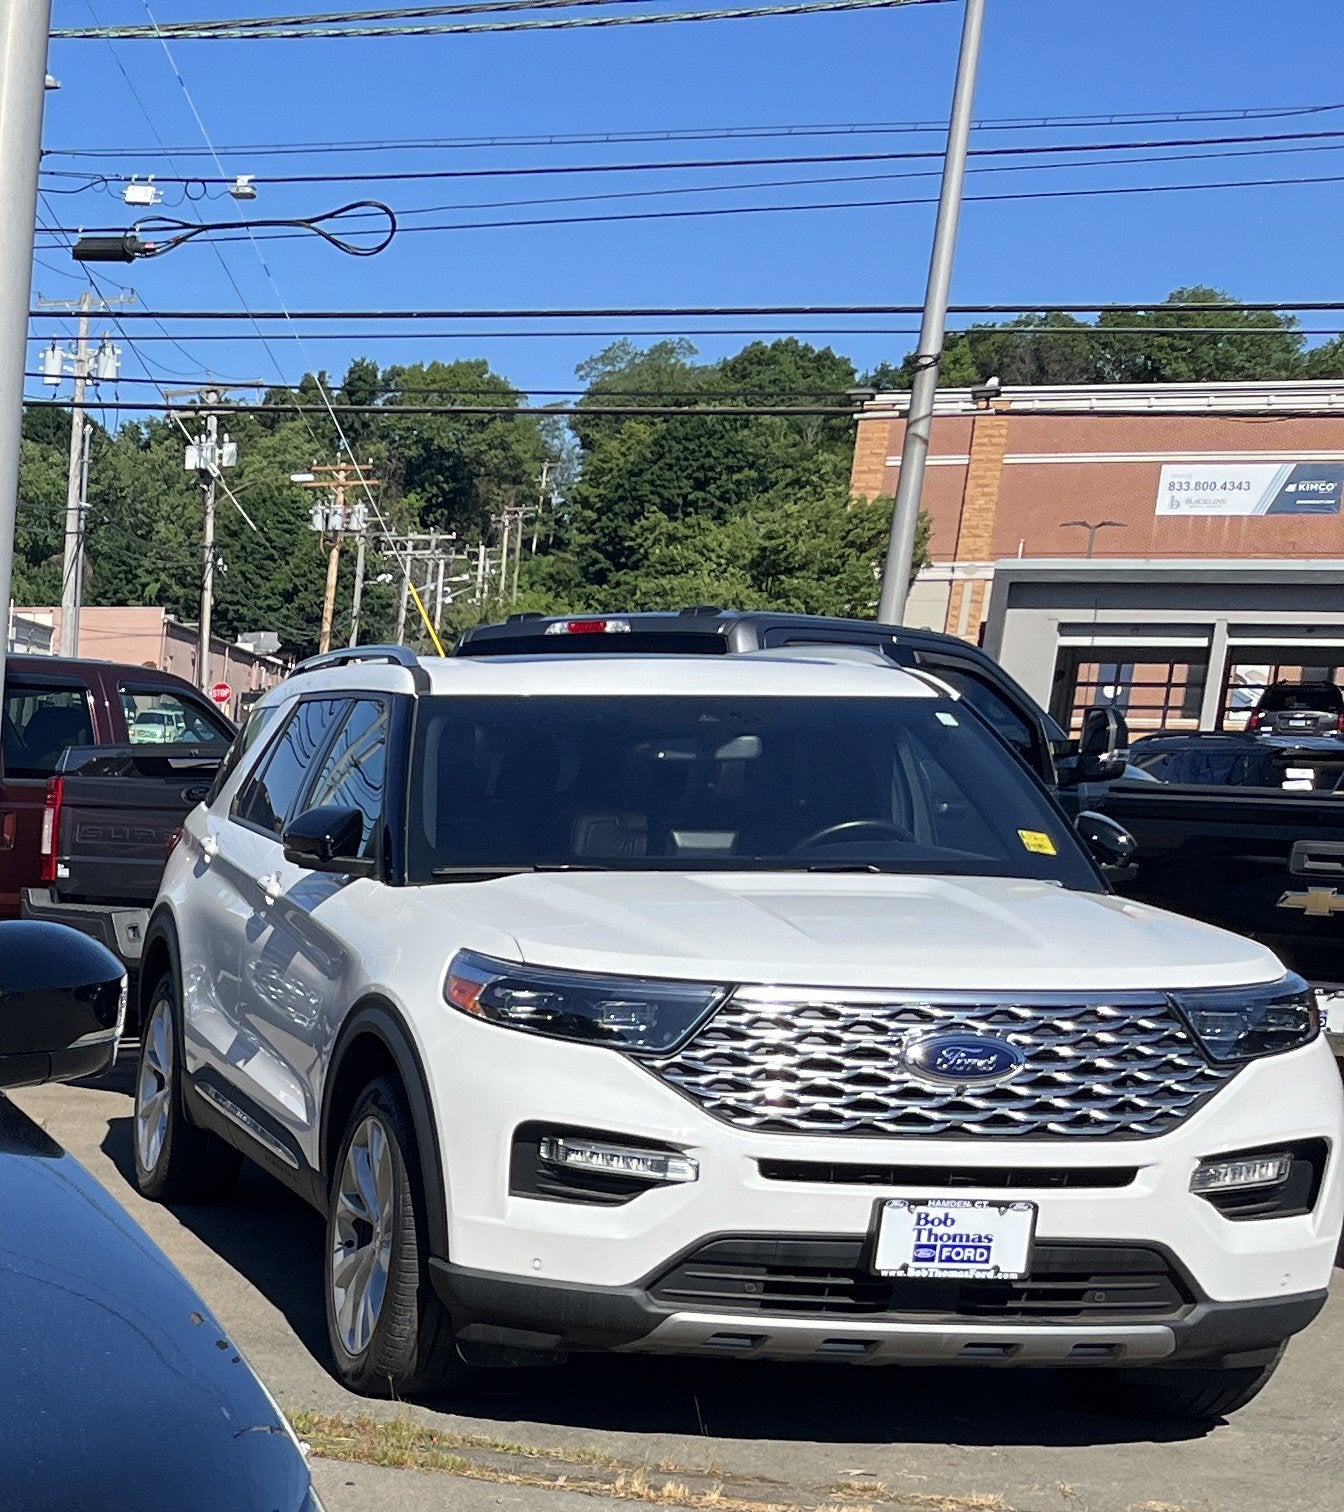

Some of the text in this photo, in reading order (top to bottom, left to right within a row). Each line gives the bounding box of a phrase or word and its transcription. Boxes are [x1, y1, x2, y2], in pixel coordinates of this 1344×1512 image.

[1168, 481, 1251, 491] 833.800.4343
[212, 689, 230, 697] STOP
[936, 1046, 998, 1072] Ford
[915, 1212, 955, 1227] Bob
[913, 1228, 994, 1243] Thomas
[941, 1248, 988, 1261] FORD
